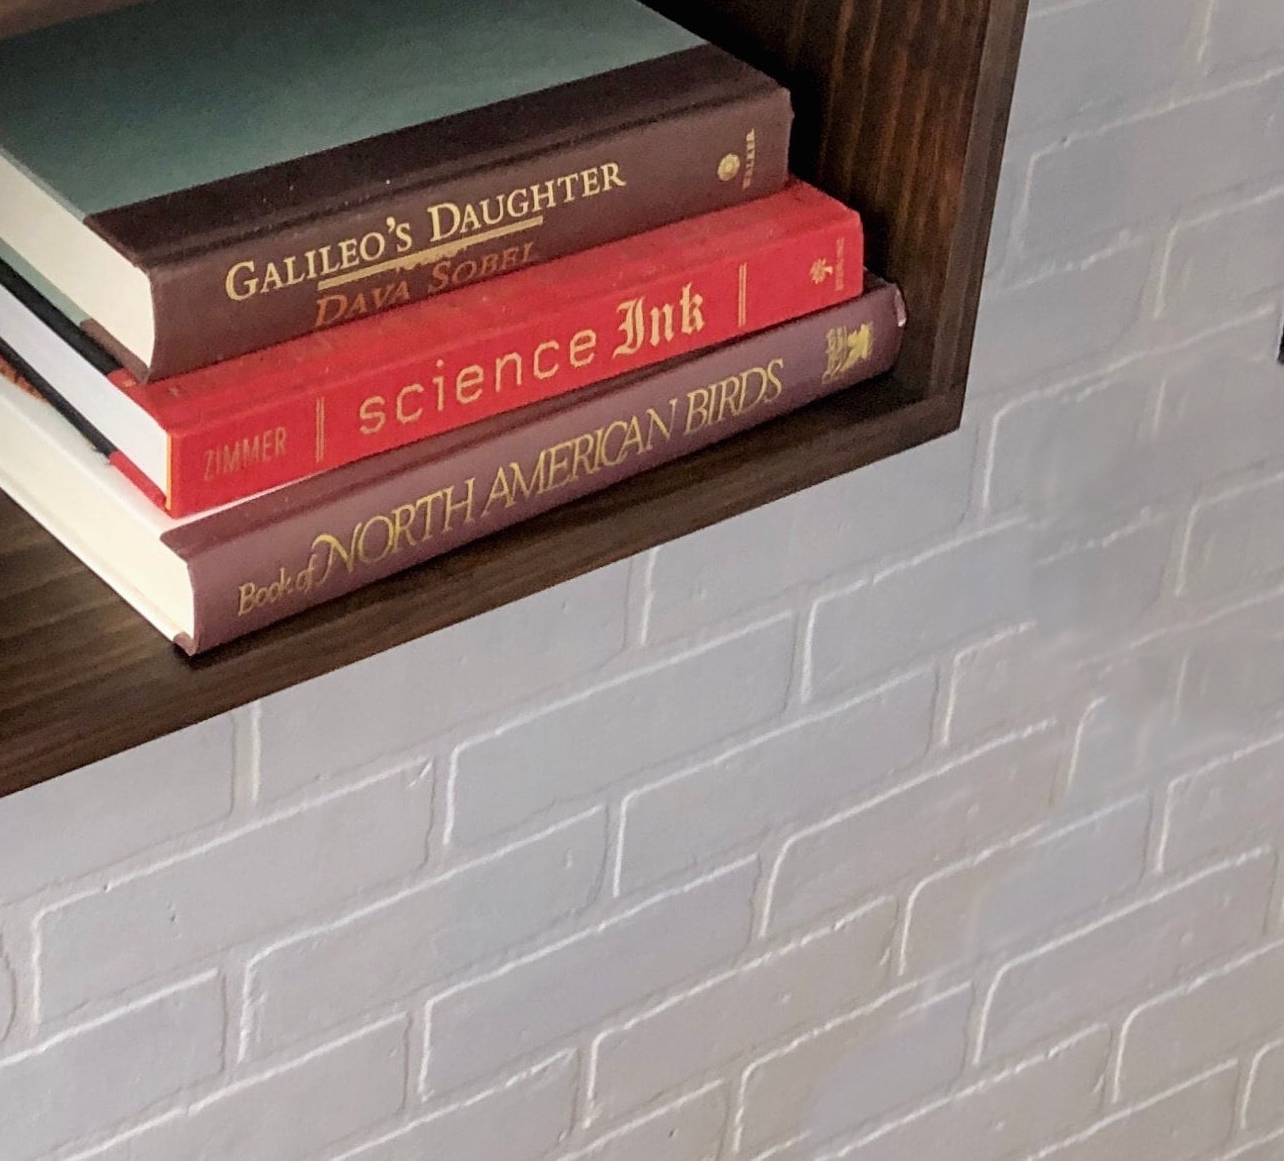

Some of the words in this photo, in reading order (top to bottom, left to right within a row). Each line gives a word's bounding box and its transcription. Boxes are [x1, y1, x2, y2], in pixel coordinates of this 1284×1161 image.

[225, 216, 413, 301] GALILEO'S
[427, 162, 626, 242] DAUGHTER
[315, 280, 411, 328] DAVA
[203, 426, 288, 482] ZIMMER
[359, 328, 597, 435] science
[612, 282, 706, 360] Ink
[237, 566, 292, 617] Book
[296, 553, 317, 593] of
[311, 476, 476, 584] NORTH
[481, 397, 678, 518] AMERICAN
[683, 357, 785, 436] BIRDS
